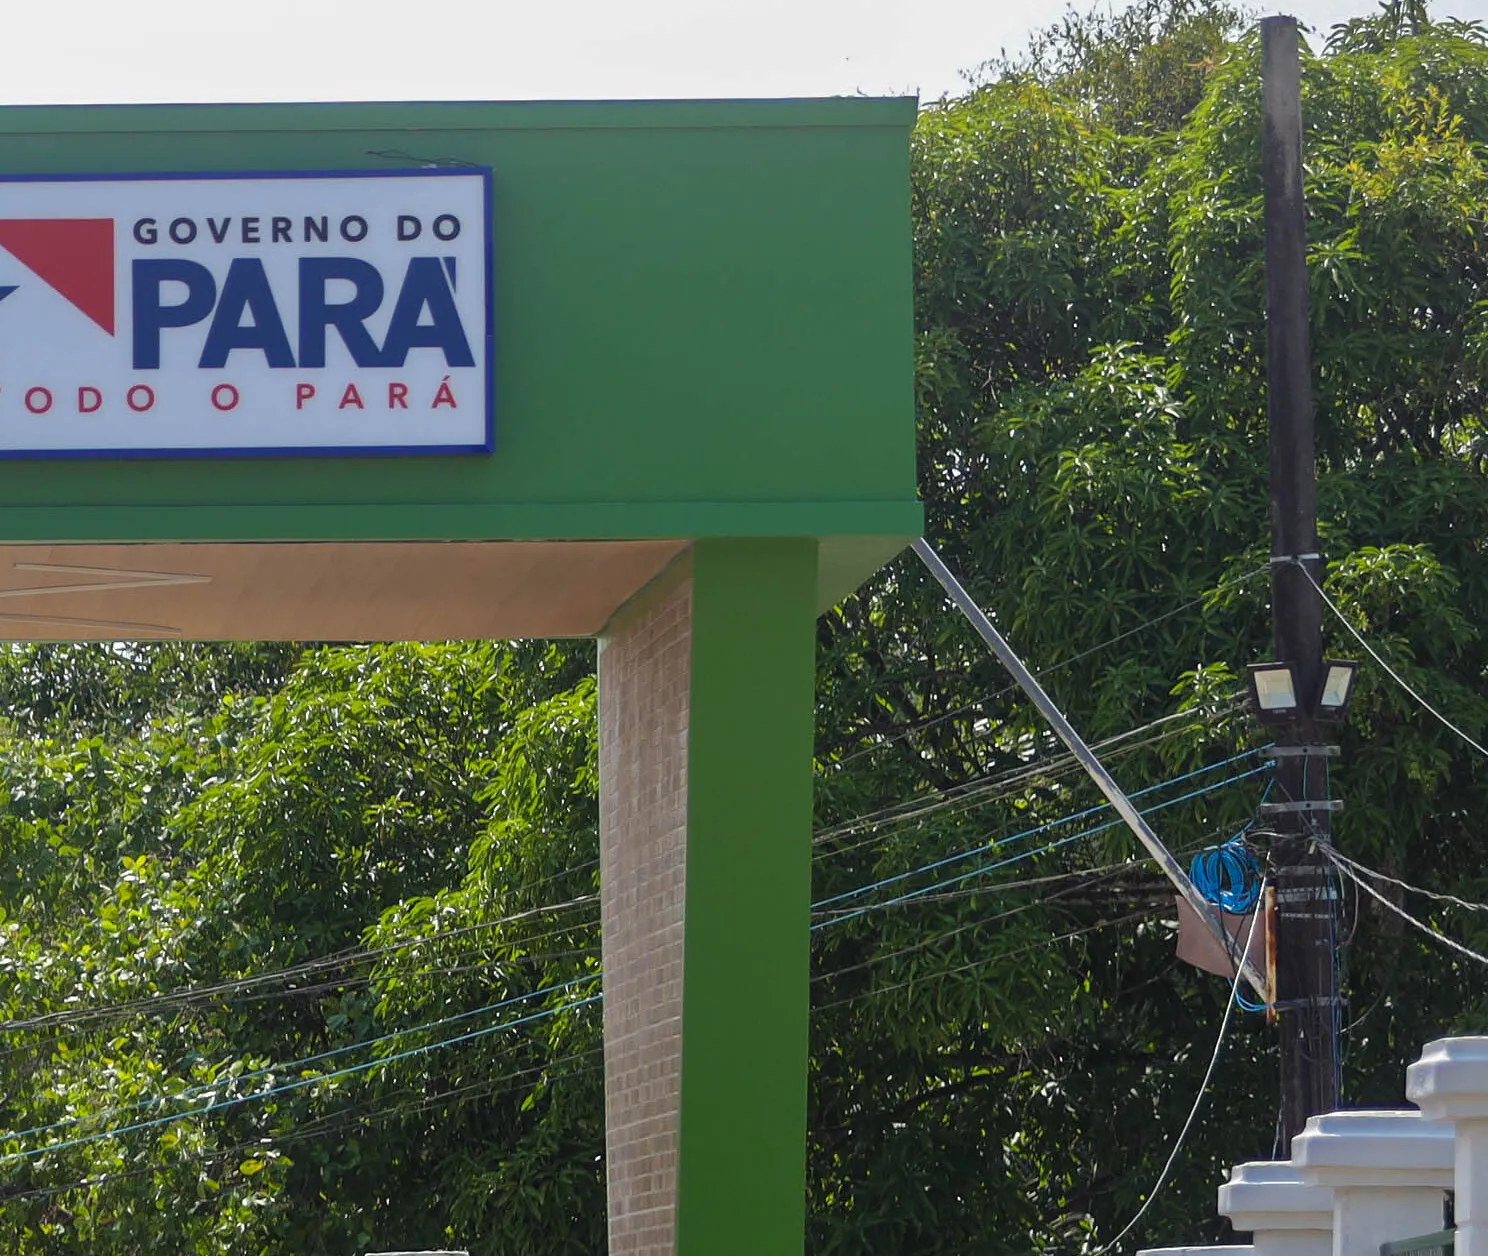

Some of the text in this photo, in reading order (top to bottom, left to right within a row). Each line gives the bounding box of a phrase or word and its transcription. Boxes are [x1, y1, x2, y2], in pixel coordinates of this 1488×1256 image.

[132, 213, 461, 245] GOVERNO DO
[211, 383, 239, 411] O
[296, 375, 457, 410] PARÁ
